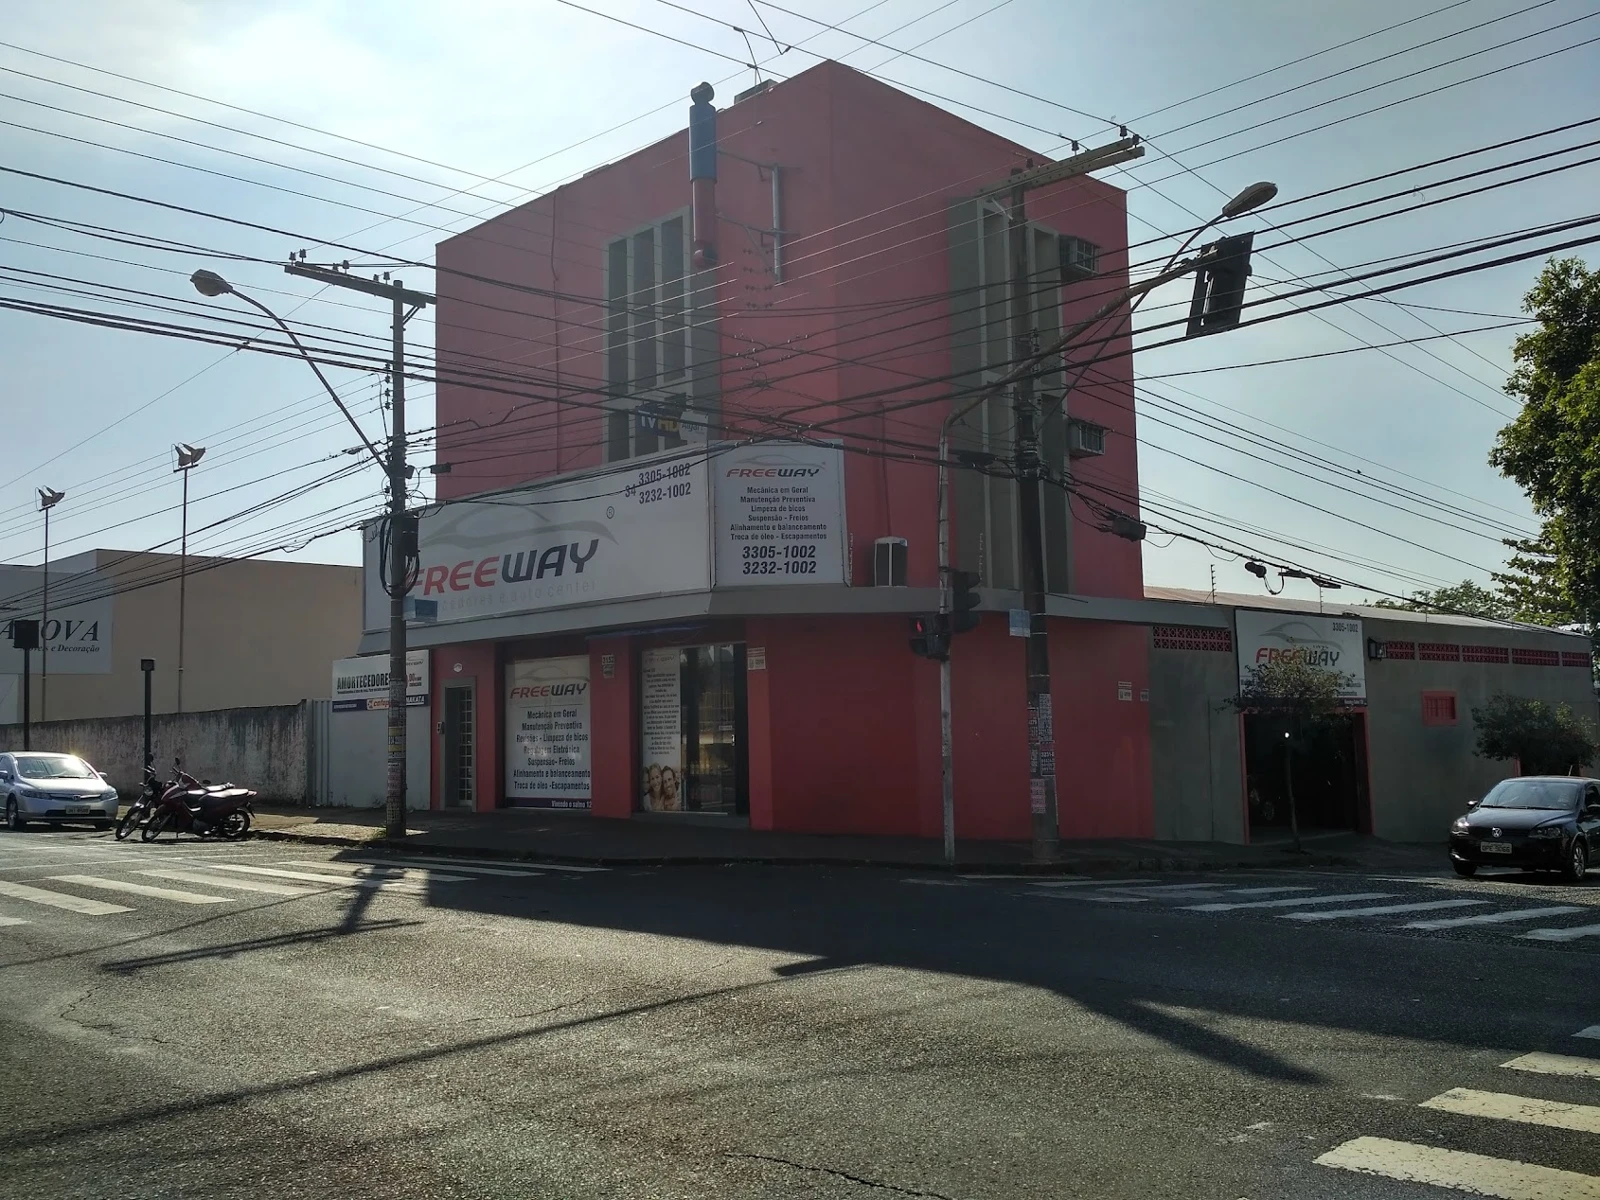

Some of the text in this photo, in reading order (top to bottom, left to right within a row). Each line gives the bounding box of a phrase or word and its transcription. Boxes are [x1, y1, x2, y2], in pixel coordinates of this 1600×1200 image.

[639, 462, 690, 485] 3305-1002
[726, 468, 820, 478] FREEWAY
[639, 482, 691, 504] 3232-1002
[747, 486, 778, 494] Mecânica
[792, 486, 809, 494] Geral
[740, 496, 780, 504] Manutenção
[751, 505, 777, 513] Limpeza
[748, 514, 809, 522] Suspensão Freios
[778, 523, 827, 531] balanceamento
[760, 532, 774, 540] óleo
[781, 533, 827, 541] Escapamentos
[742, 545, 816, 559] 3305-1002
[742, 561, 817, 575] 3232-1002
[0, 619, 99, 641] AOVA
[57, 644, 100, 654] Decoração
[510, 682, 587, 699] FREEWAY
[562, 709, 578, 718] Geral
[522, 721, 582, 732] Manutenção Preventiva
[543, 734, 564, 743] Limpeza
[566, 733, 572, 741] de
[574, 732, 588, 741] bicos
[558, 757, 576, 766] Freios
[513, 769, 544, 778] Alinhamento
[550, 769, 590, 778] balanceamento
[514, 781, 528, 789] Troca
[530, 781, 536, 789] de
